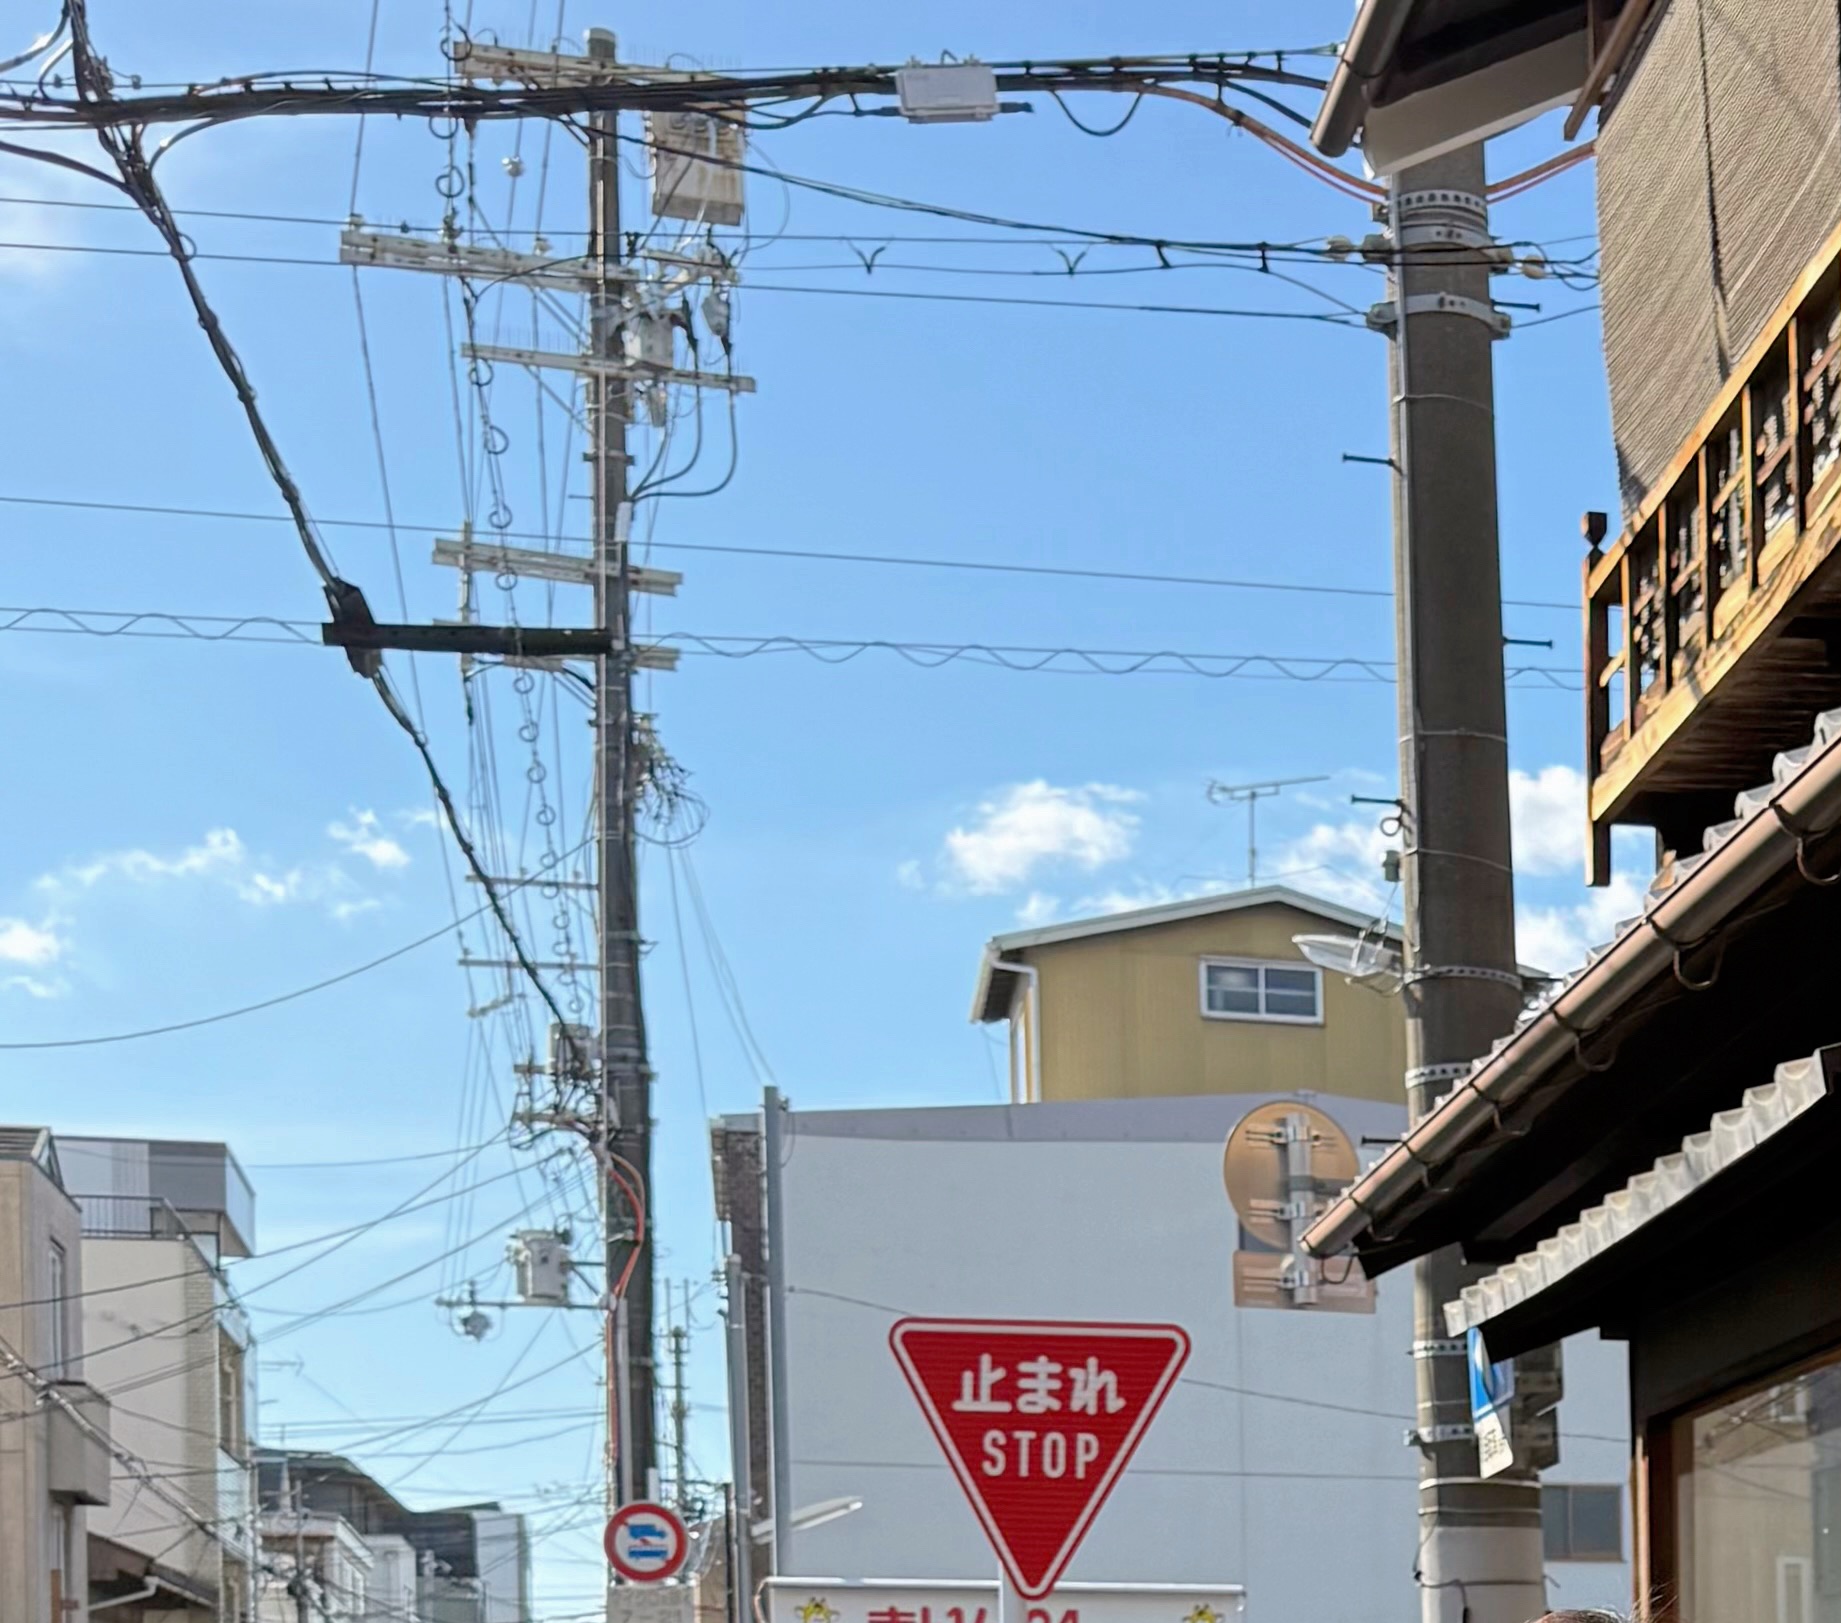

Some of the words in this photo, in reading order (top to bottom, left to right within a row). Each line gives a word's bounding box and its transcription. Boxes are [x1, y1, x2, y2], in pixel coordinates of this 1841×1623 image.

[952, 1353, 1127, 1416] 止まれ
[981, 1429, 1099, 1480] STOP
